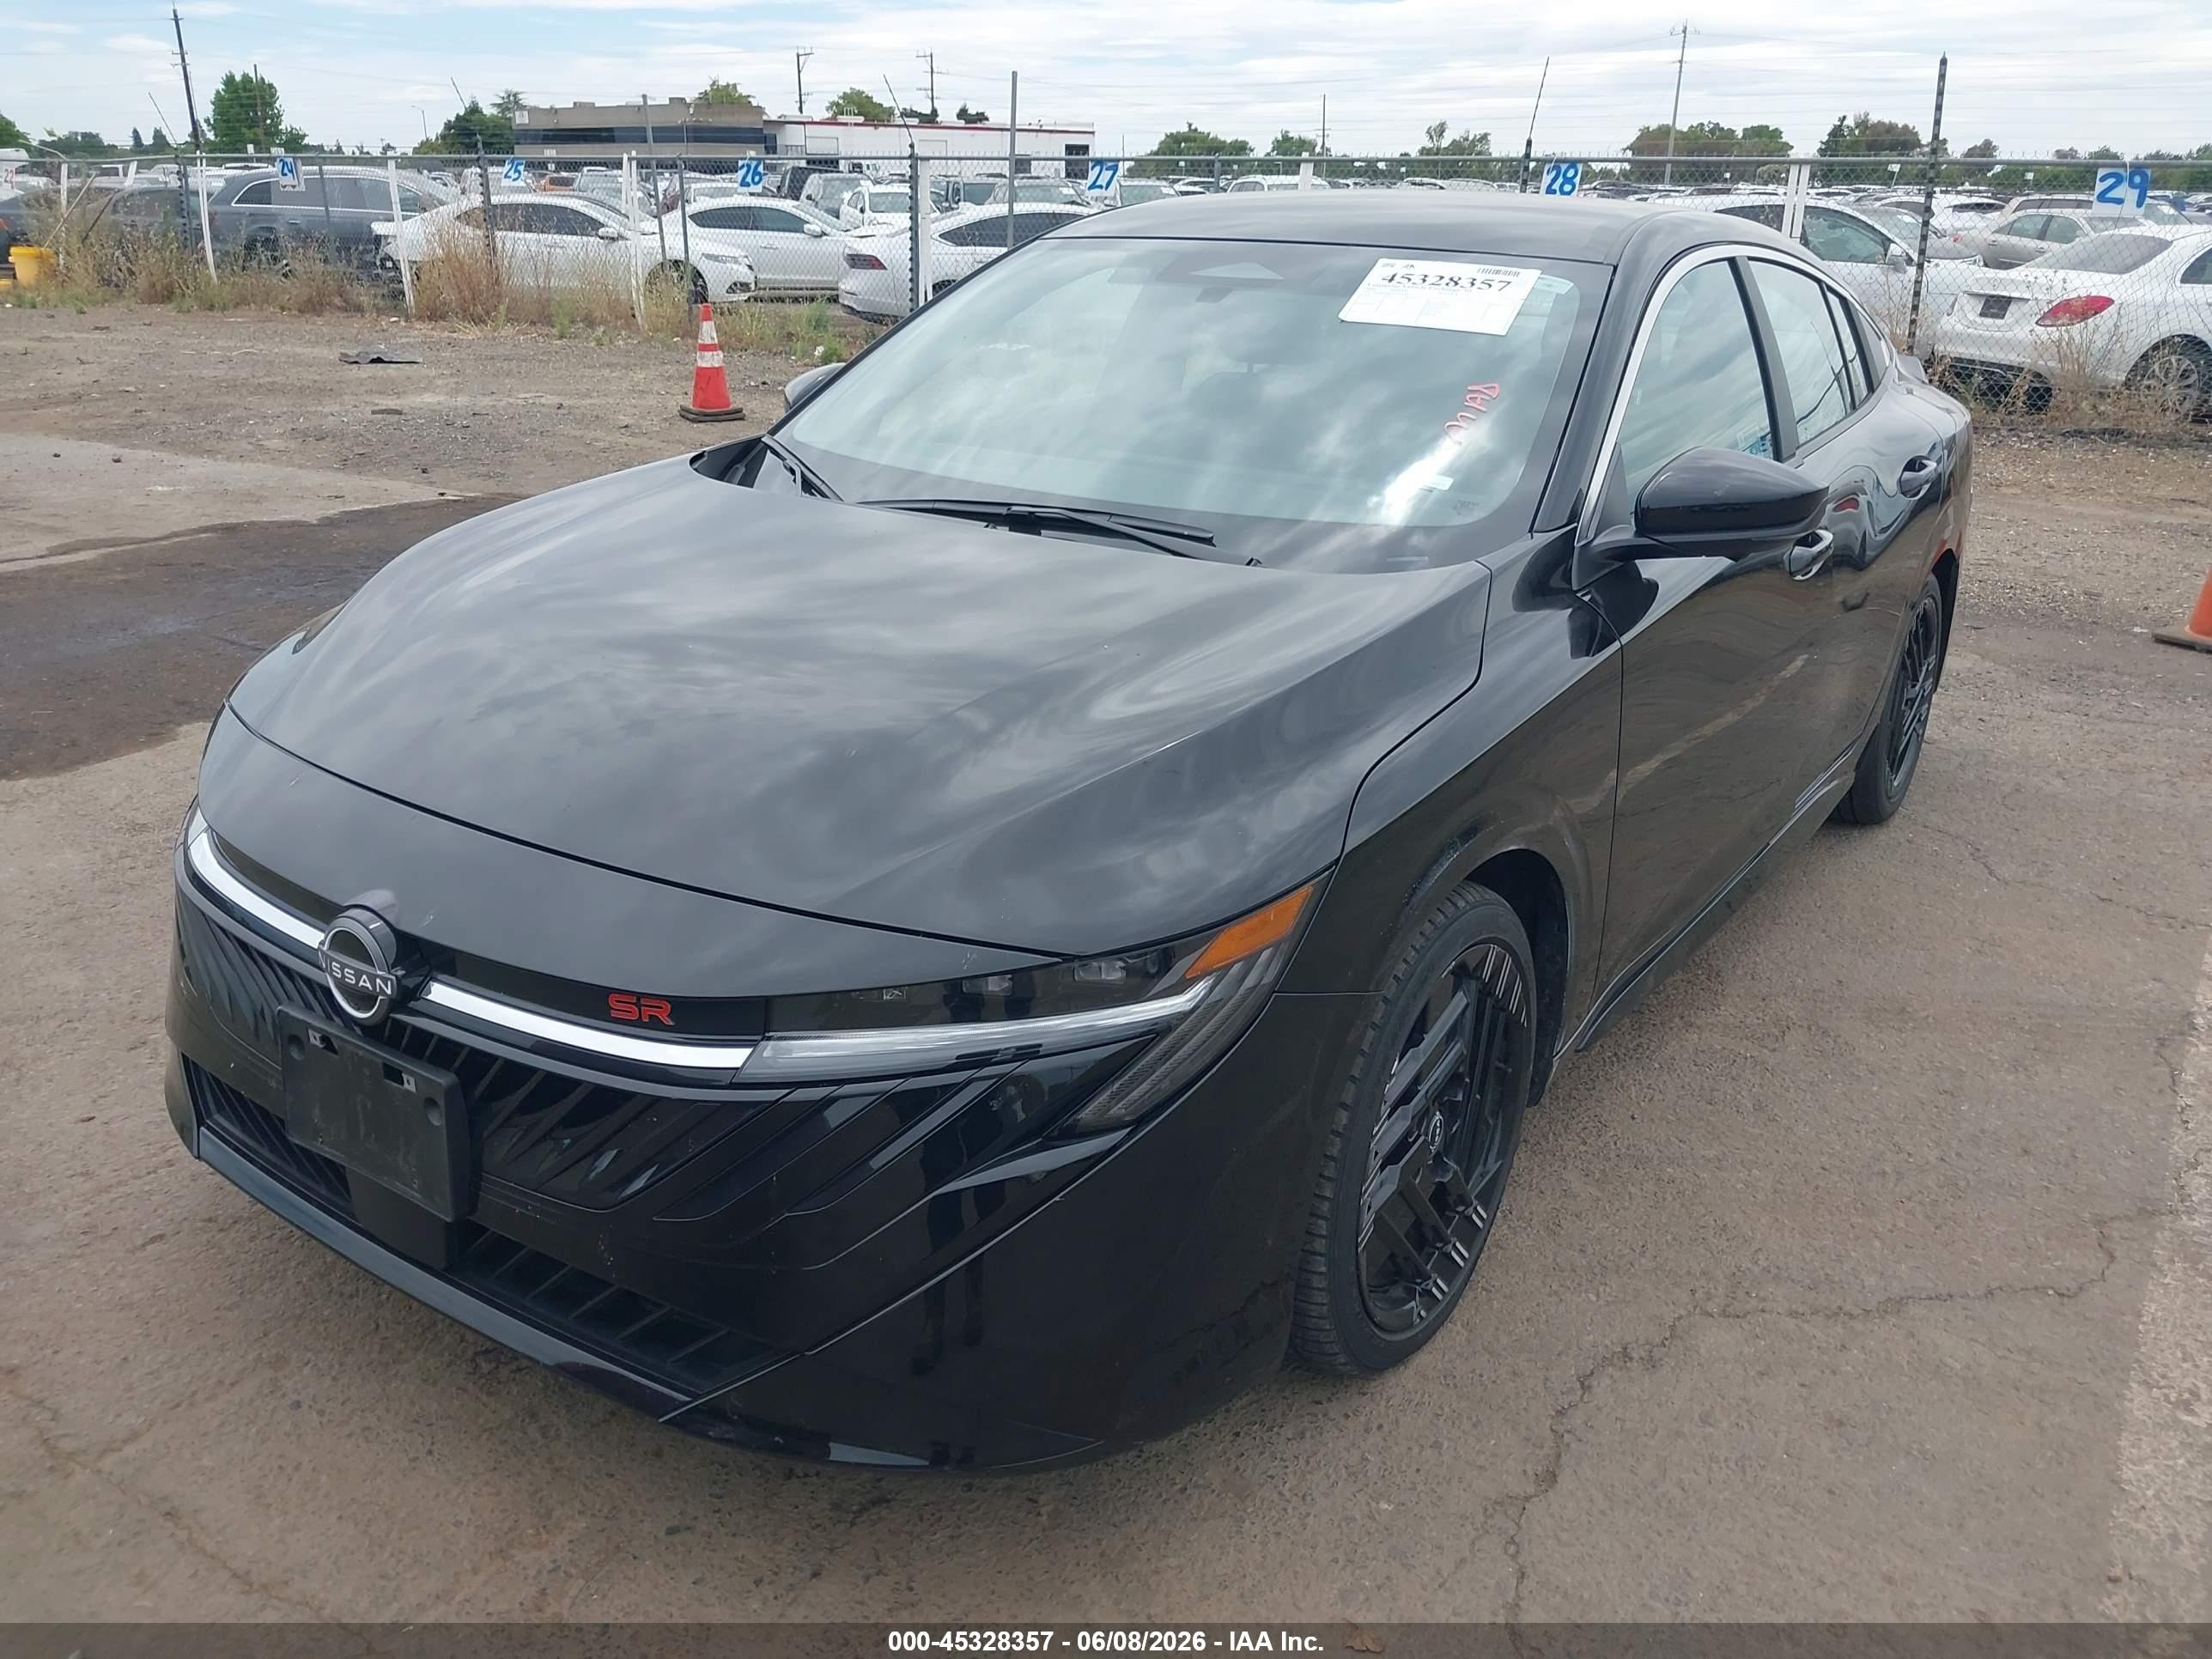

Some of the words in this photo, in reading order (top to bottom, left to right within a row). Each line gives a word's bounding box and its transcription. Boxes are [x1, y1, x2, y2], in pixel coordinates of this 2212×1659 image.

[279, 158, 295, 180] 24
[503, 159, 525, 182] 25
[738, 159, 763, 187] 26
[1087, 161, 1119, 191] 27
[1546, 161, 1578, 196] 28
[2096, 166, 2149, 209] 29
[1381, 272, 1513, 292] 45328357
[318, 948, 392, 995] NISSAN
[608, 993, 675, 1025] SR
